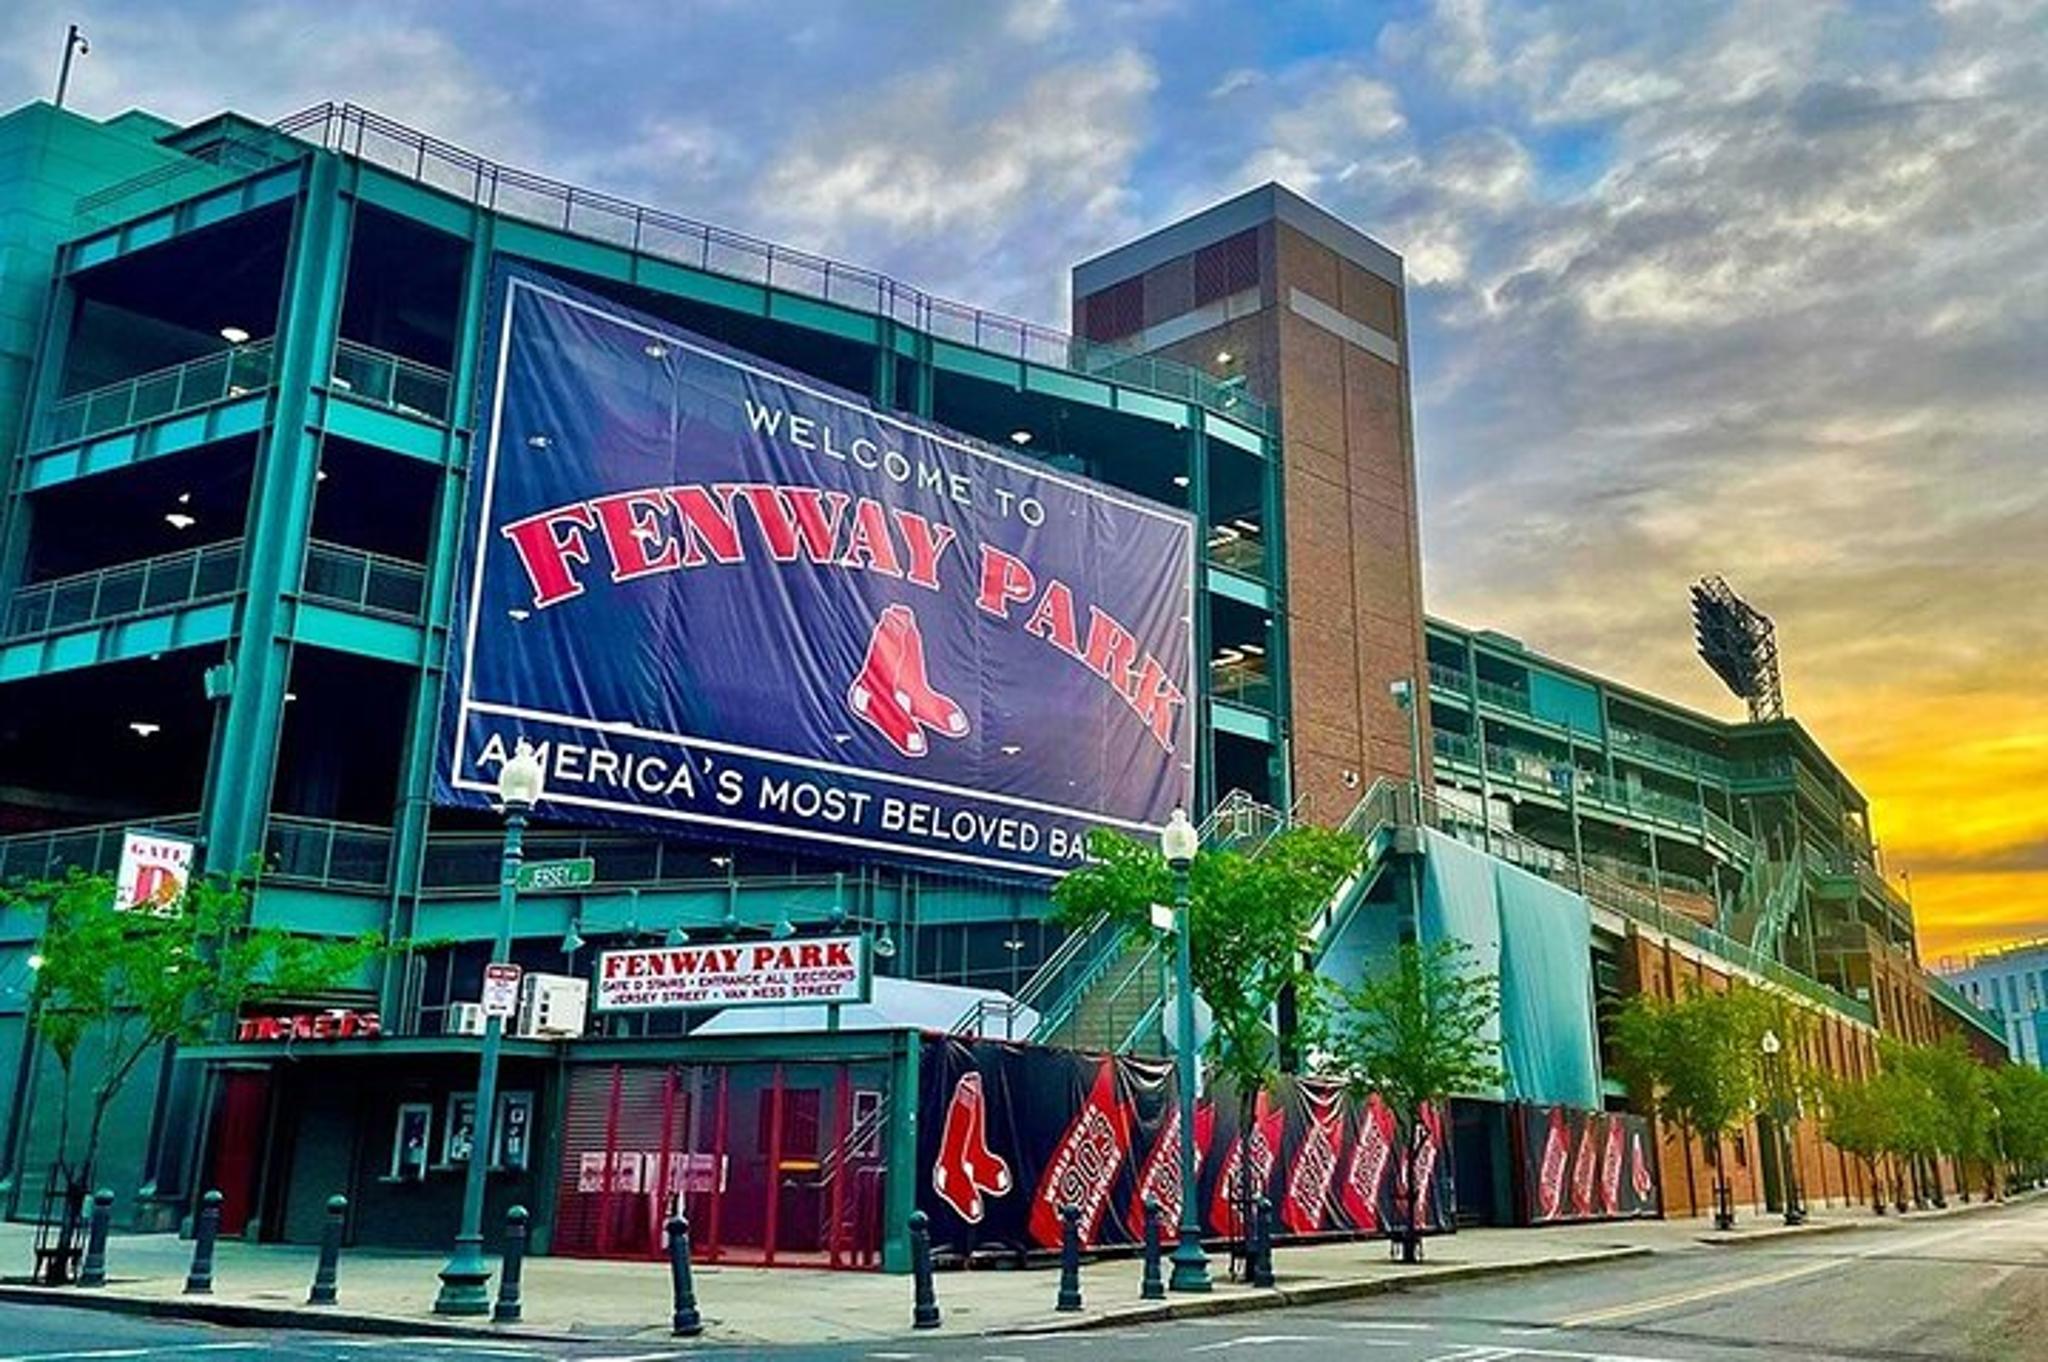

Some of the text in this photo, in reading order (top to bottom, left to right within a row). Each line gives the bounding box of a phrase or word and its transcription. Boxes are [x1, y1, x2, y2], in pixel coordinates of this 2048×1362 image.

[744, 400, 1046, 529] WELCOME TO
[501, 482, 1187, 754] FENWAY PARK
[476, 733, 1110, 866] AMERICA'S MOST BELOVED BAL
[131, 843, 183, 861] GATE
[133, 863, 180, 907] D
[530, 865, 570, 889] JERSEY
[602, 968, 856, 993] GATE D STAIRS ENTRANCE ALL SECTIONS
[605, 942, 852, 979] FENWAY PARK
[611, 982, 841, 1005] JERSEY STREET VAN NESS STREET
[1044, 1147, 1073, 1202] WORLD
